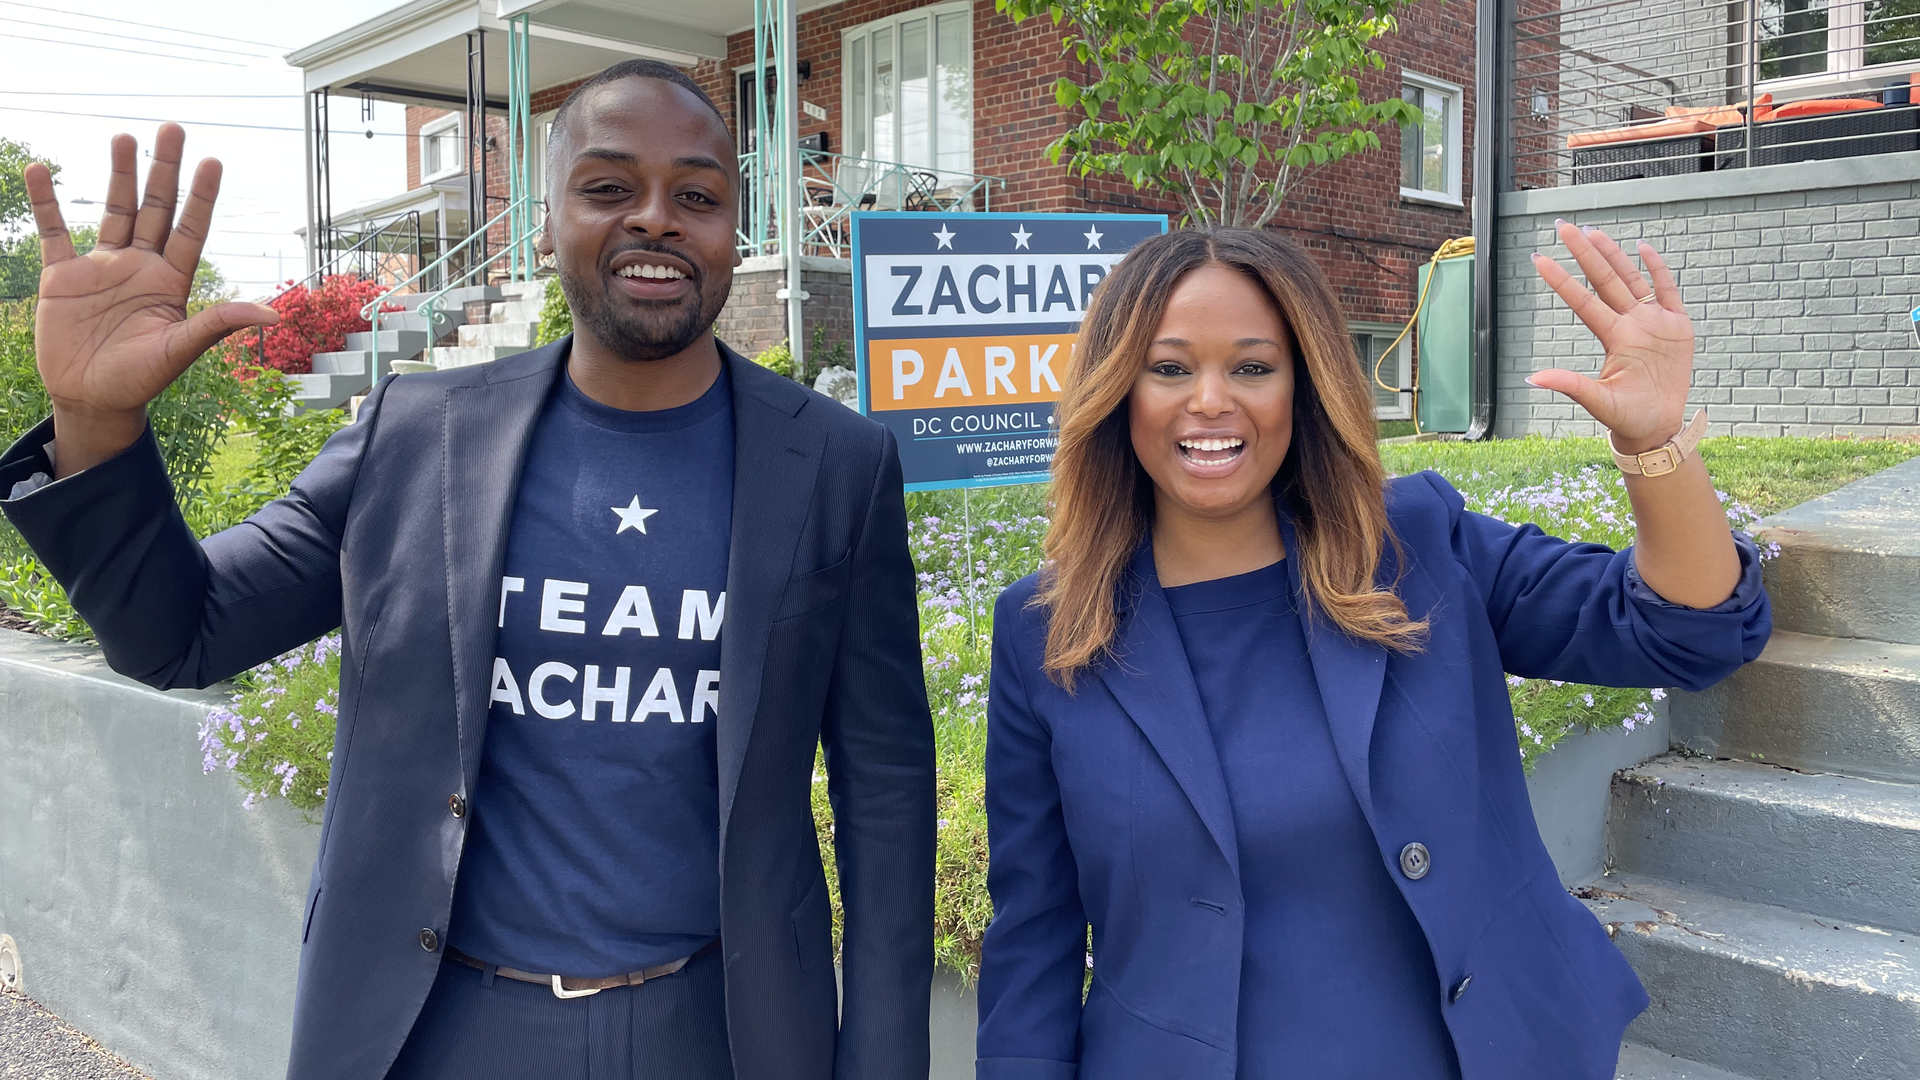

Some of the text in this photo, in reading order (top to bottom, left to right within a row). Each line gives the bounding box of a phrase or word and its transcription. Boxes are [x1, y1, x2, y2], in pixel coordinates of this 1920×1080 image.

[890, 264, 1117, 316] ZACHAR
[891, 343, 1077, 400] PARK
[913, 411, 1041, 435] DC COUNCIL
[956, 438, 1061, 454] WWW.ZACHARYFORWA
